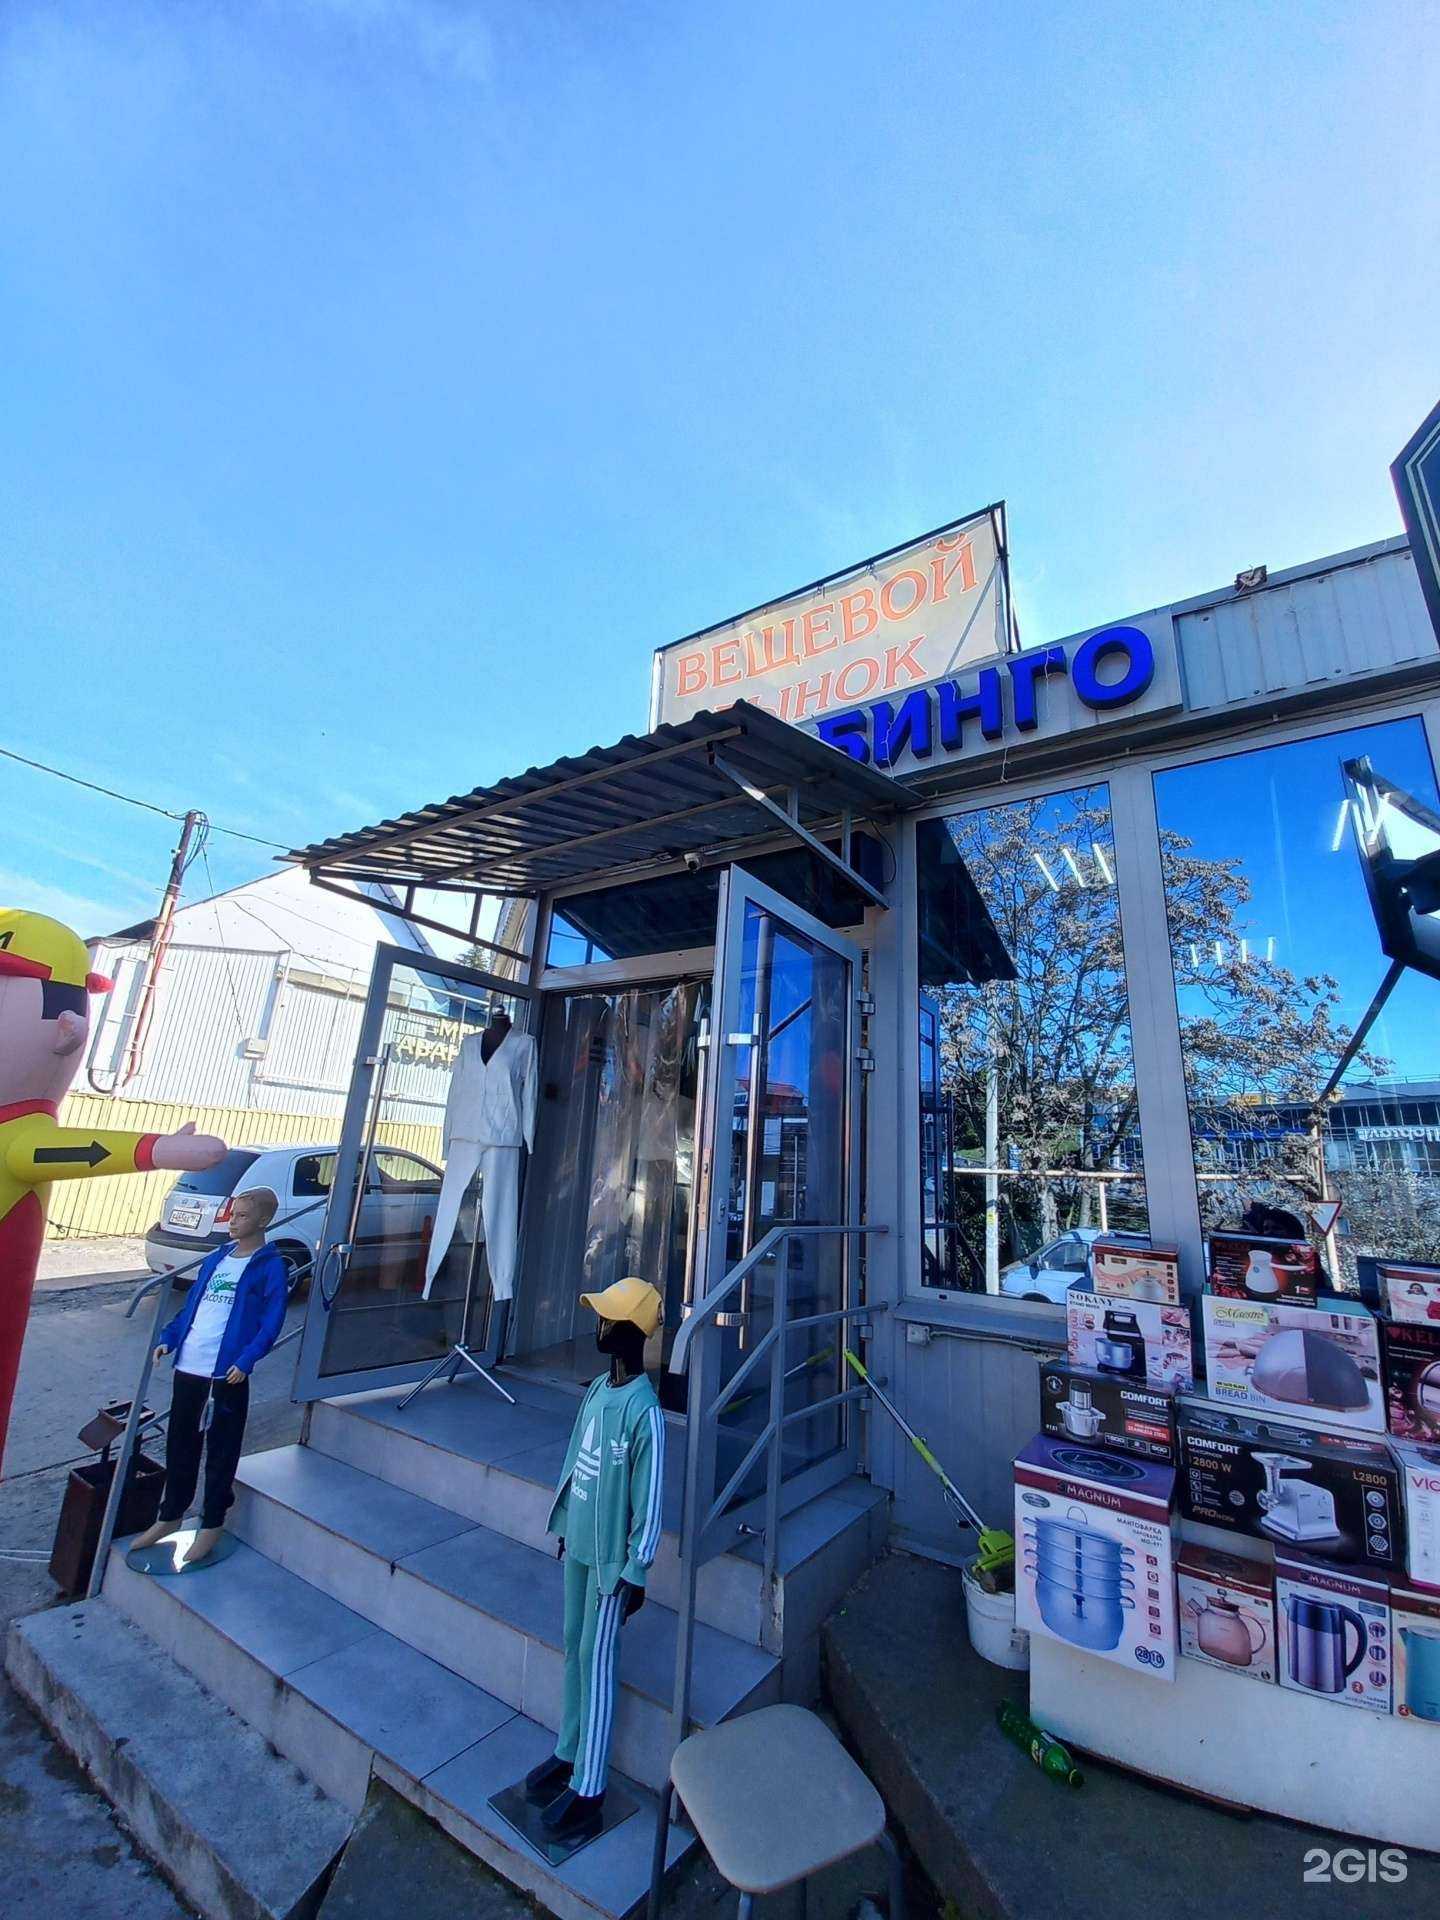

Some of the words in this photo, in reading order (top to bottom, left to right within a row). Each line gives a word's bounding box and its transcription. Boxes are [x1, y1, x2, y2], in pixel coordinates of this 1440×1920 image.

[676, 532, 978, 697] ВЕЩЕВОЙ
[714, 634, 927, 721] ЫНОК
[816, 626, 1155, 769] БИНГО
[1069, 1291, 1112, 1307] SOKANY
[1120, 1390, 1168, 1407] COMFORT
[1215, 1387, 1248, 1400] BREAD
[1187, 1436, 1240, 1455] COMFORT
[1192, 1456, 1218, 1470] 2800
[1221, 1462, 1232, 1473] W
[1353, 1470, 1388, 1486] L2800
[1066, 1484, 1121, 1508] MAGNUM
[1116, 1517, 1162, 1535] МАНТОВАРКА
[1309, 1575, 1361, 1595] MAGNUM
